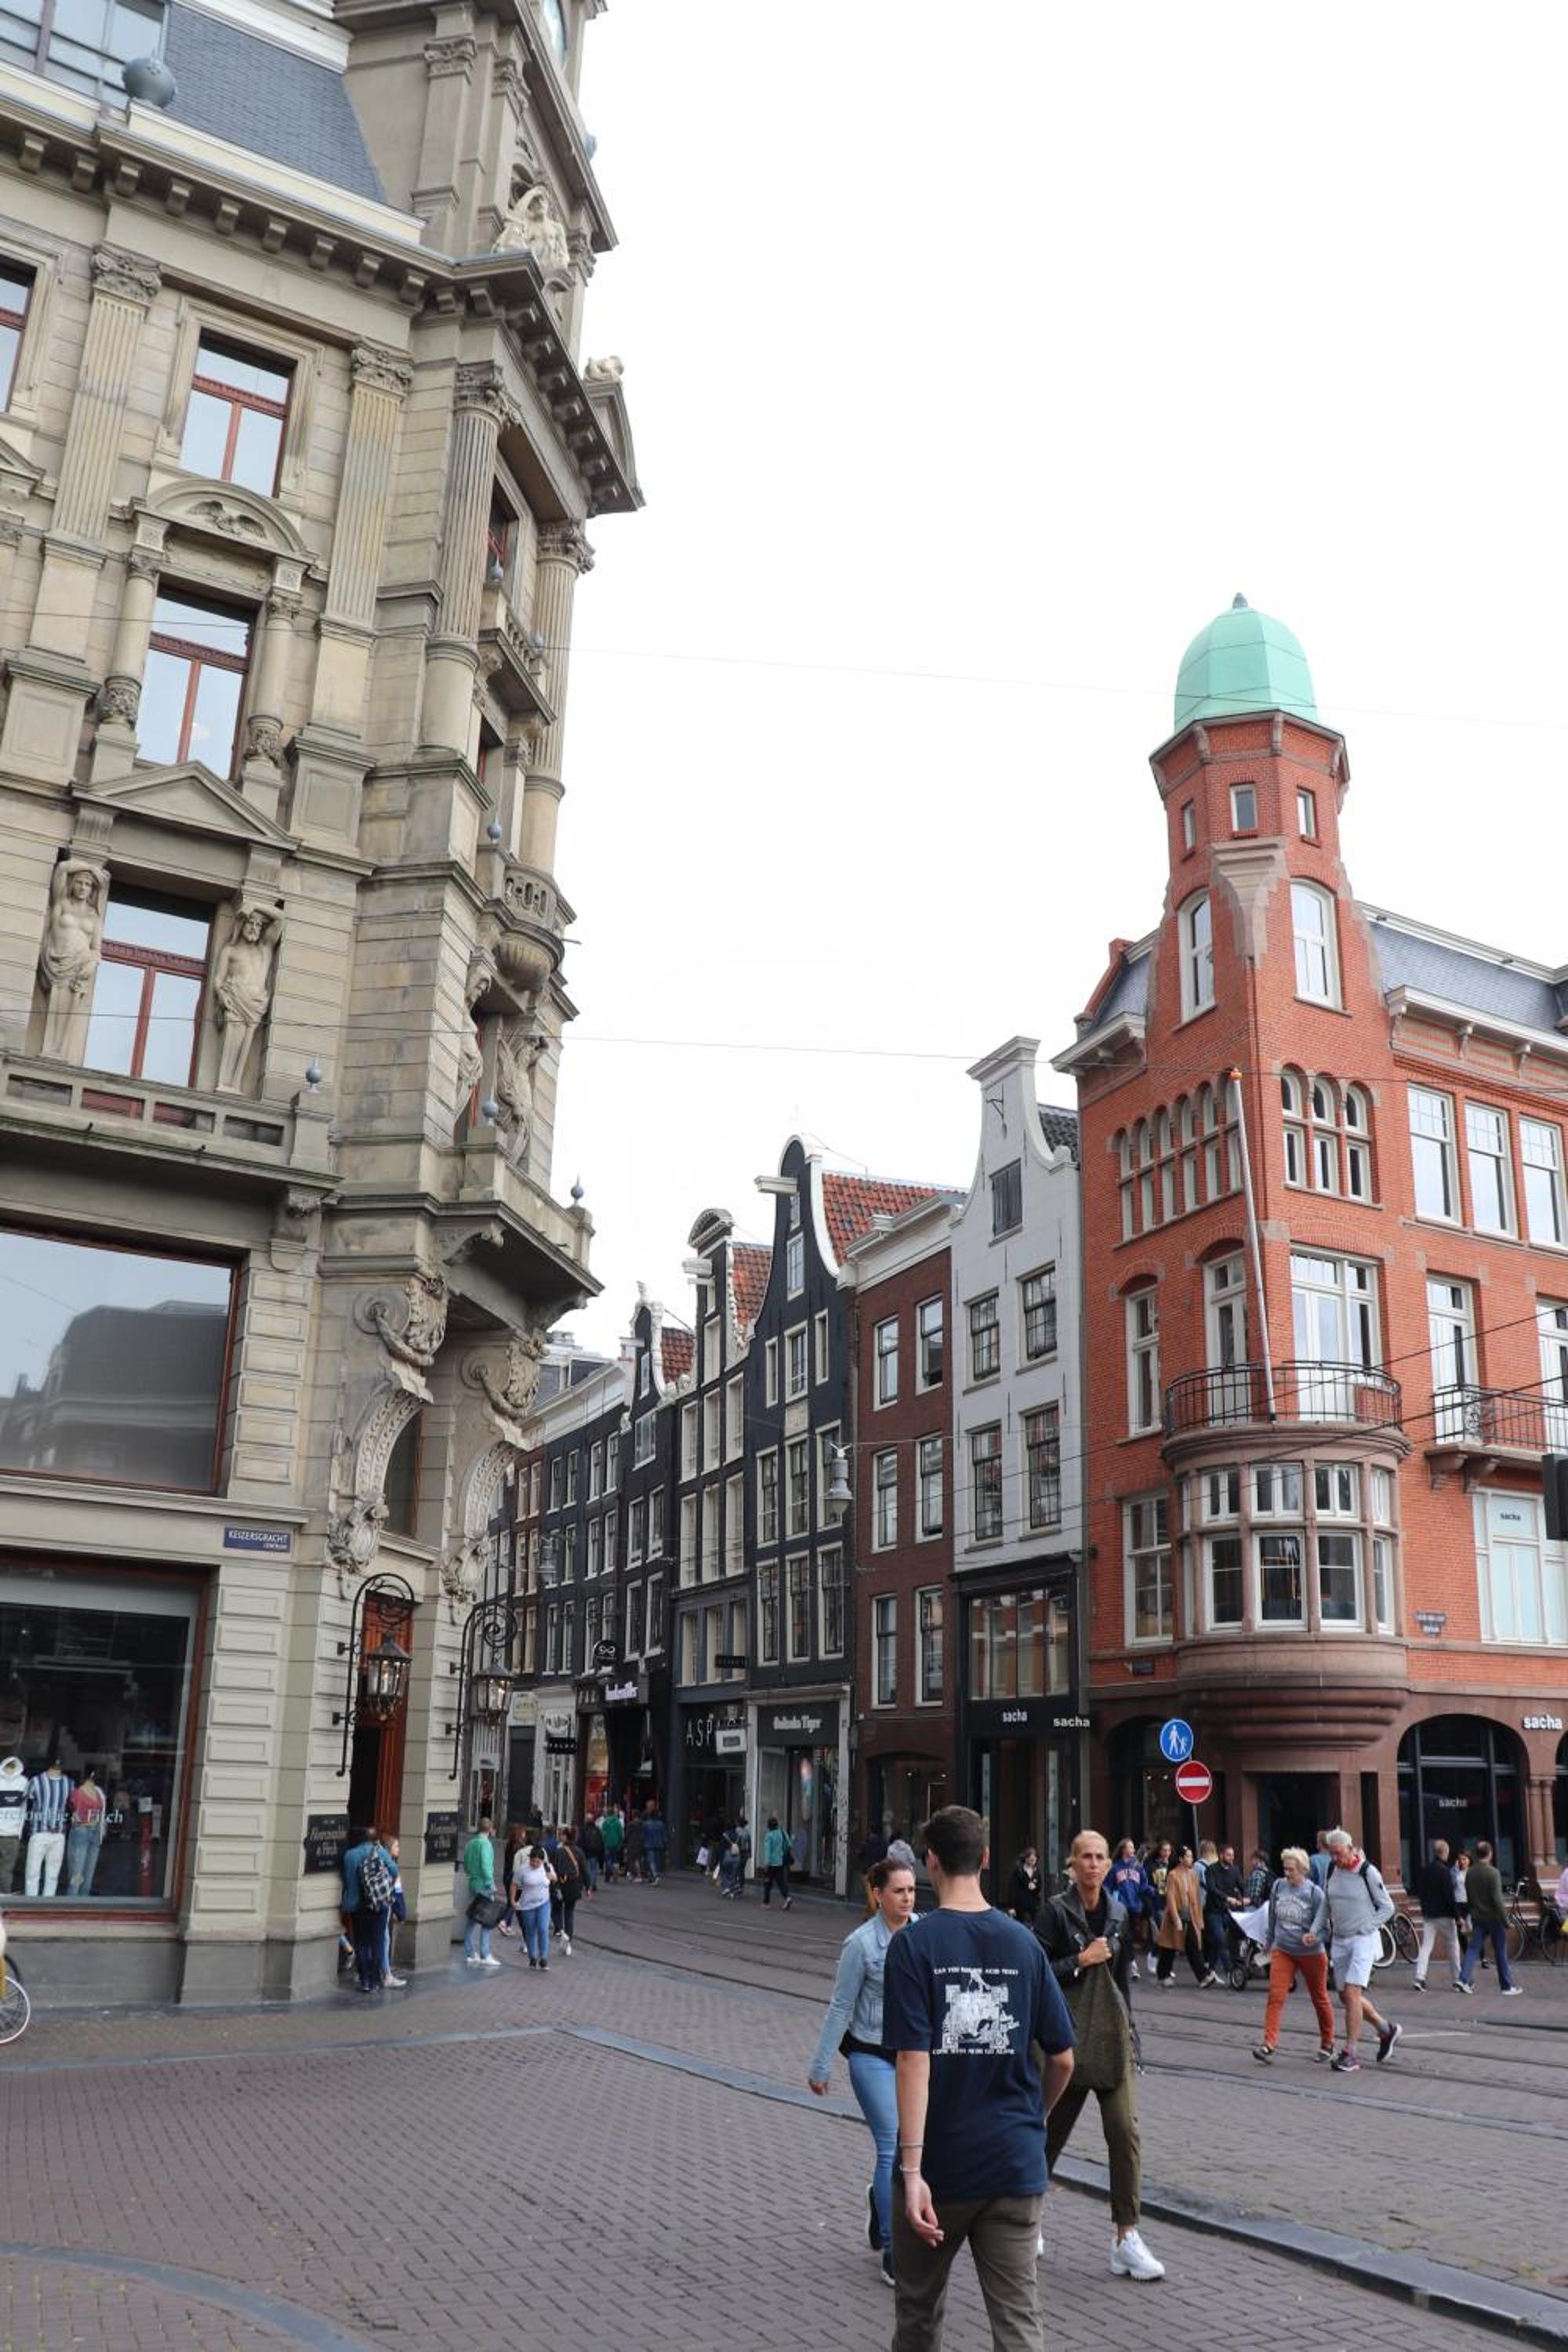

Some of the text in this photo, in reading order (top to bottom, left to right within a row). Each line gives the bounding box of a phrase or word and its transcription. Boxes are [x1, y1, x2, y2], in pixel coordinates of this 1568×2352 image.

[1003, 1708, 1028, 1722] sacha
[1053, 1715, 1091, 1727] sacha
[1523, 1714, 1563, 1730] sacha
[1439, 1798, 1468, 1808] sacha
